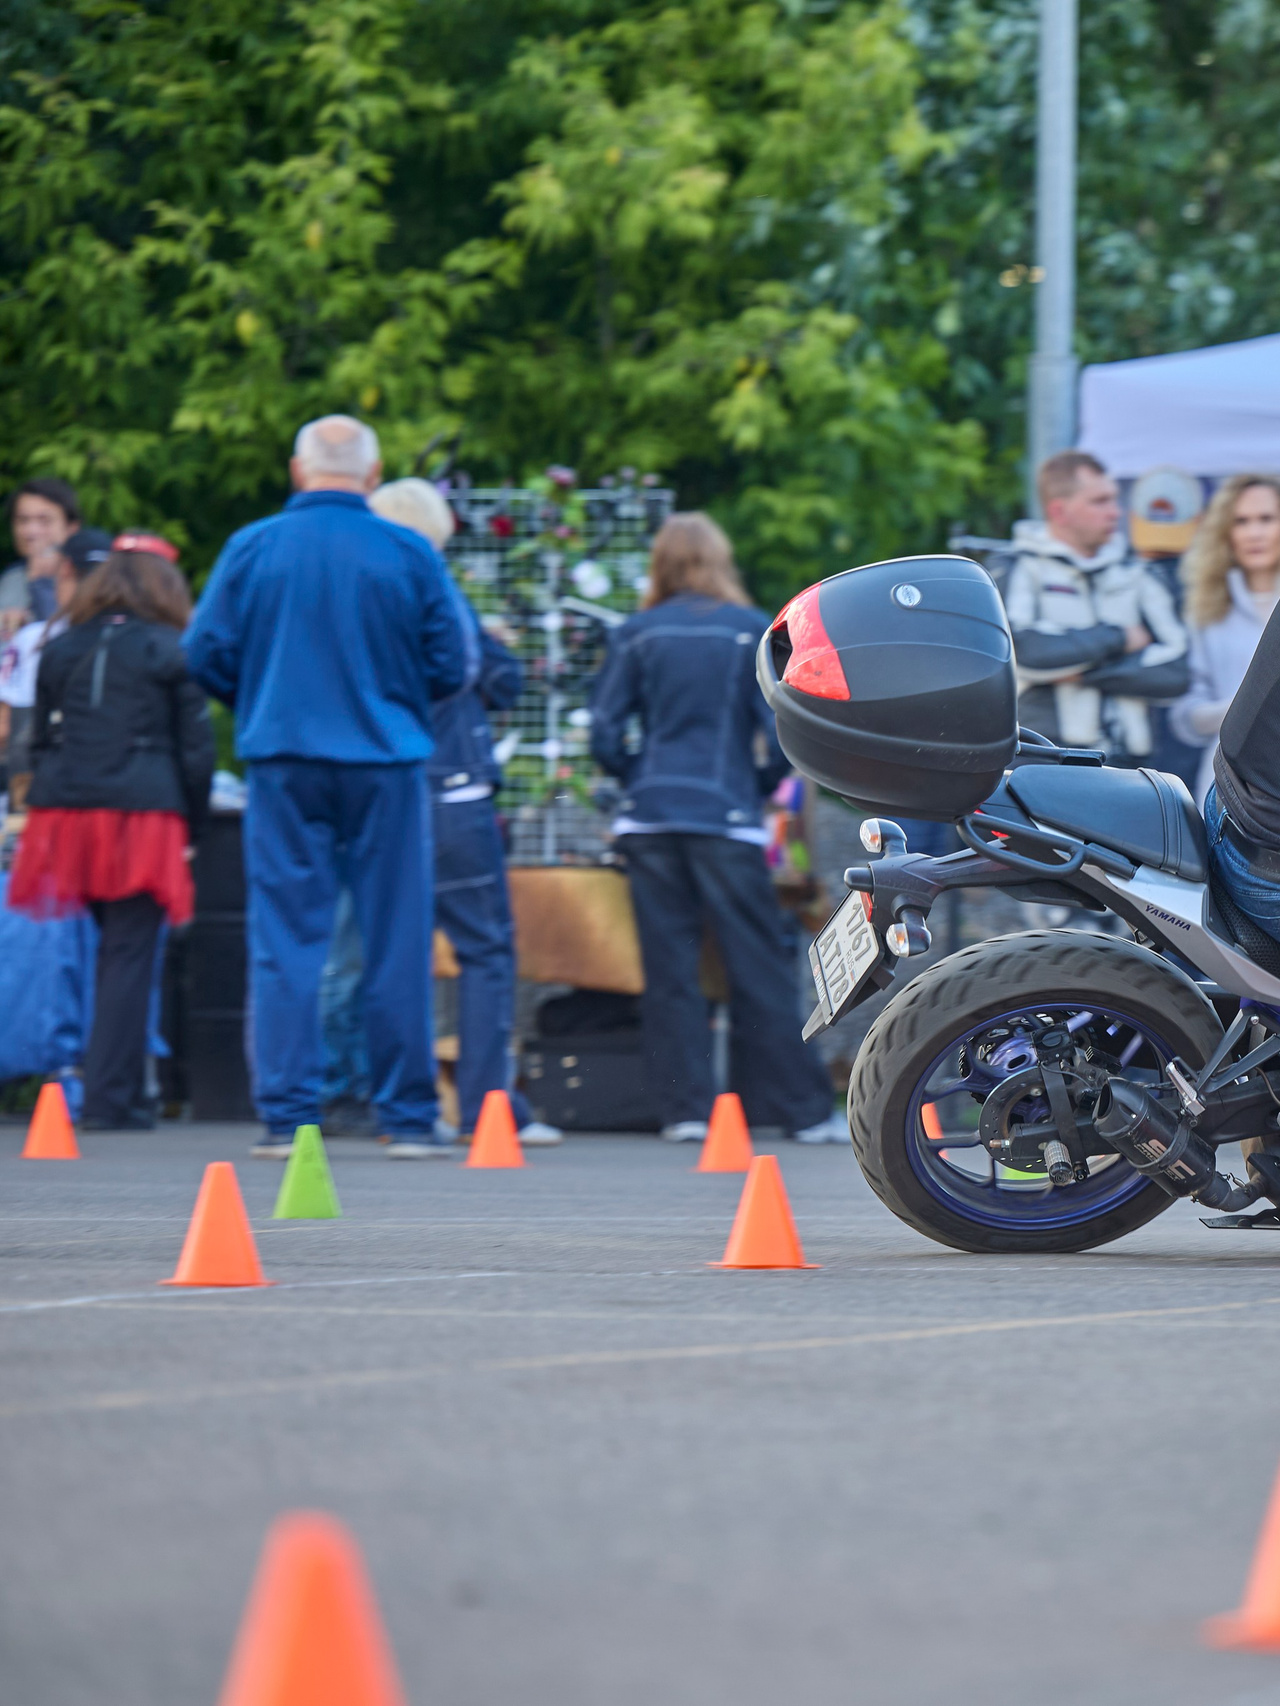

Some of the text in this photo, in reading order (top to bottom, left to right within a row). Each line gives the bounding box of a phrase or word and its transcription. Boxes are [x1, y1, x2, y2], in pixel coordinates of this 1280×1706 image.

[1145, 904, 1191, 931] YAMAHA
[846, 903, 872, 962] 1767
[846, 948, 855, 971] RUS
